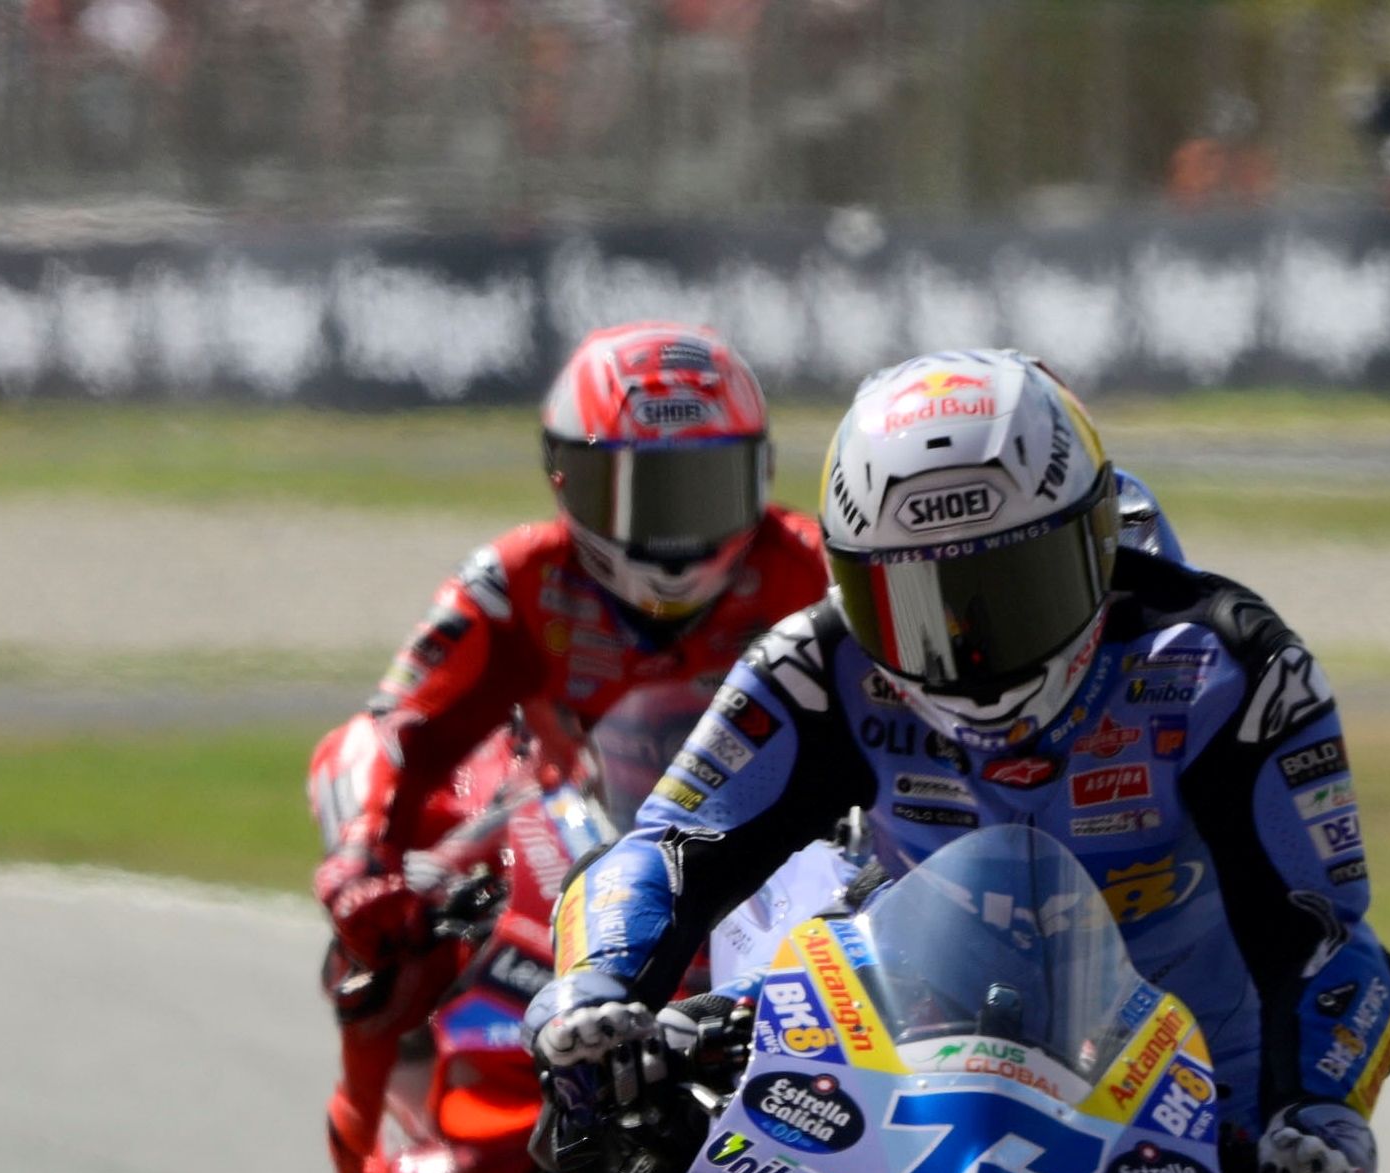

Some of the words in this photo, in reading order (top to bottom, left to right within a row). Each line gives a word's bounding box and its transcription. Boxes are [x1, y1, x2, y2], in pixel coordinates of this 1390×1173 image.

[643, 404, 702, 424] SHOEI
[885, 400, 935, 432] Red
[941, 398, 995, 417] Bull
[909, 488, 991, 525] SHOEI
[870, 550, 922, 566] GIVES
[932, 543, 974, 559] YOU
[985, 522, 1051, 549] WINGS
[1280, 741, 1338, 777] BOLD
[1083, 769, 1143, 795] ASPIRA
[800, 934, 874, 1052] Antangin
[756, 1021, 781, 1055] NEWS
[765, 982, 838, 1056] BK8
[971, 1041, 1026, 1065] AUS
[1108, 1008, 1186, 1111] Antangin
[965, 1057, 1063, 1100] GLOBAL
[1151, 1063, 1213, 1137] BK8
[760, 1096, 835, 1142] Galicia
[769, 1078, 851, 1127] Estrella
